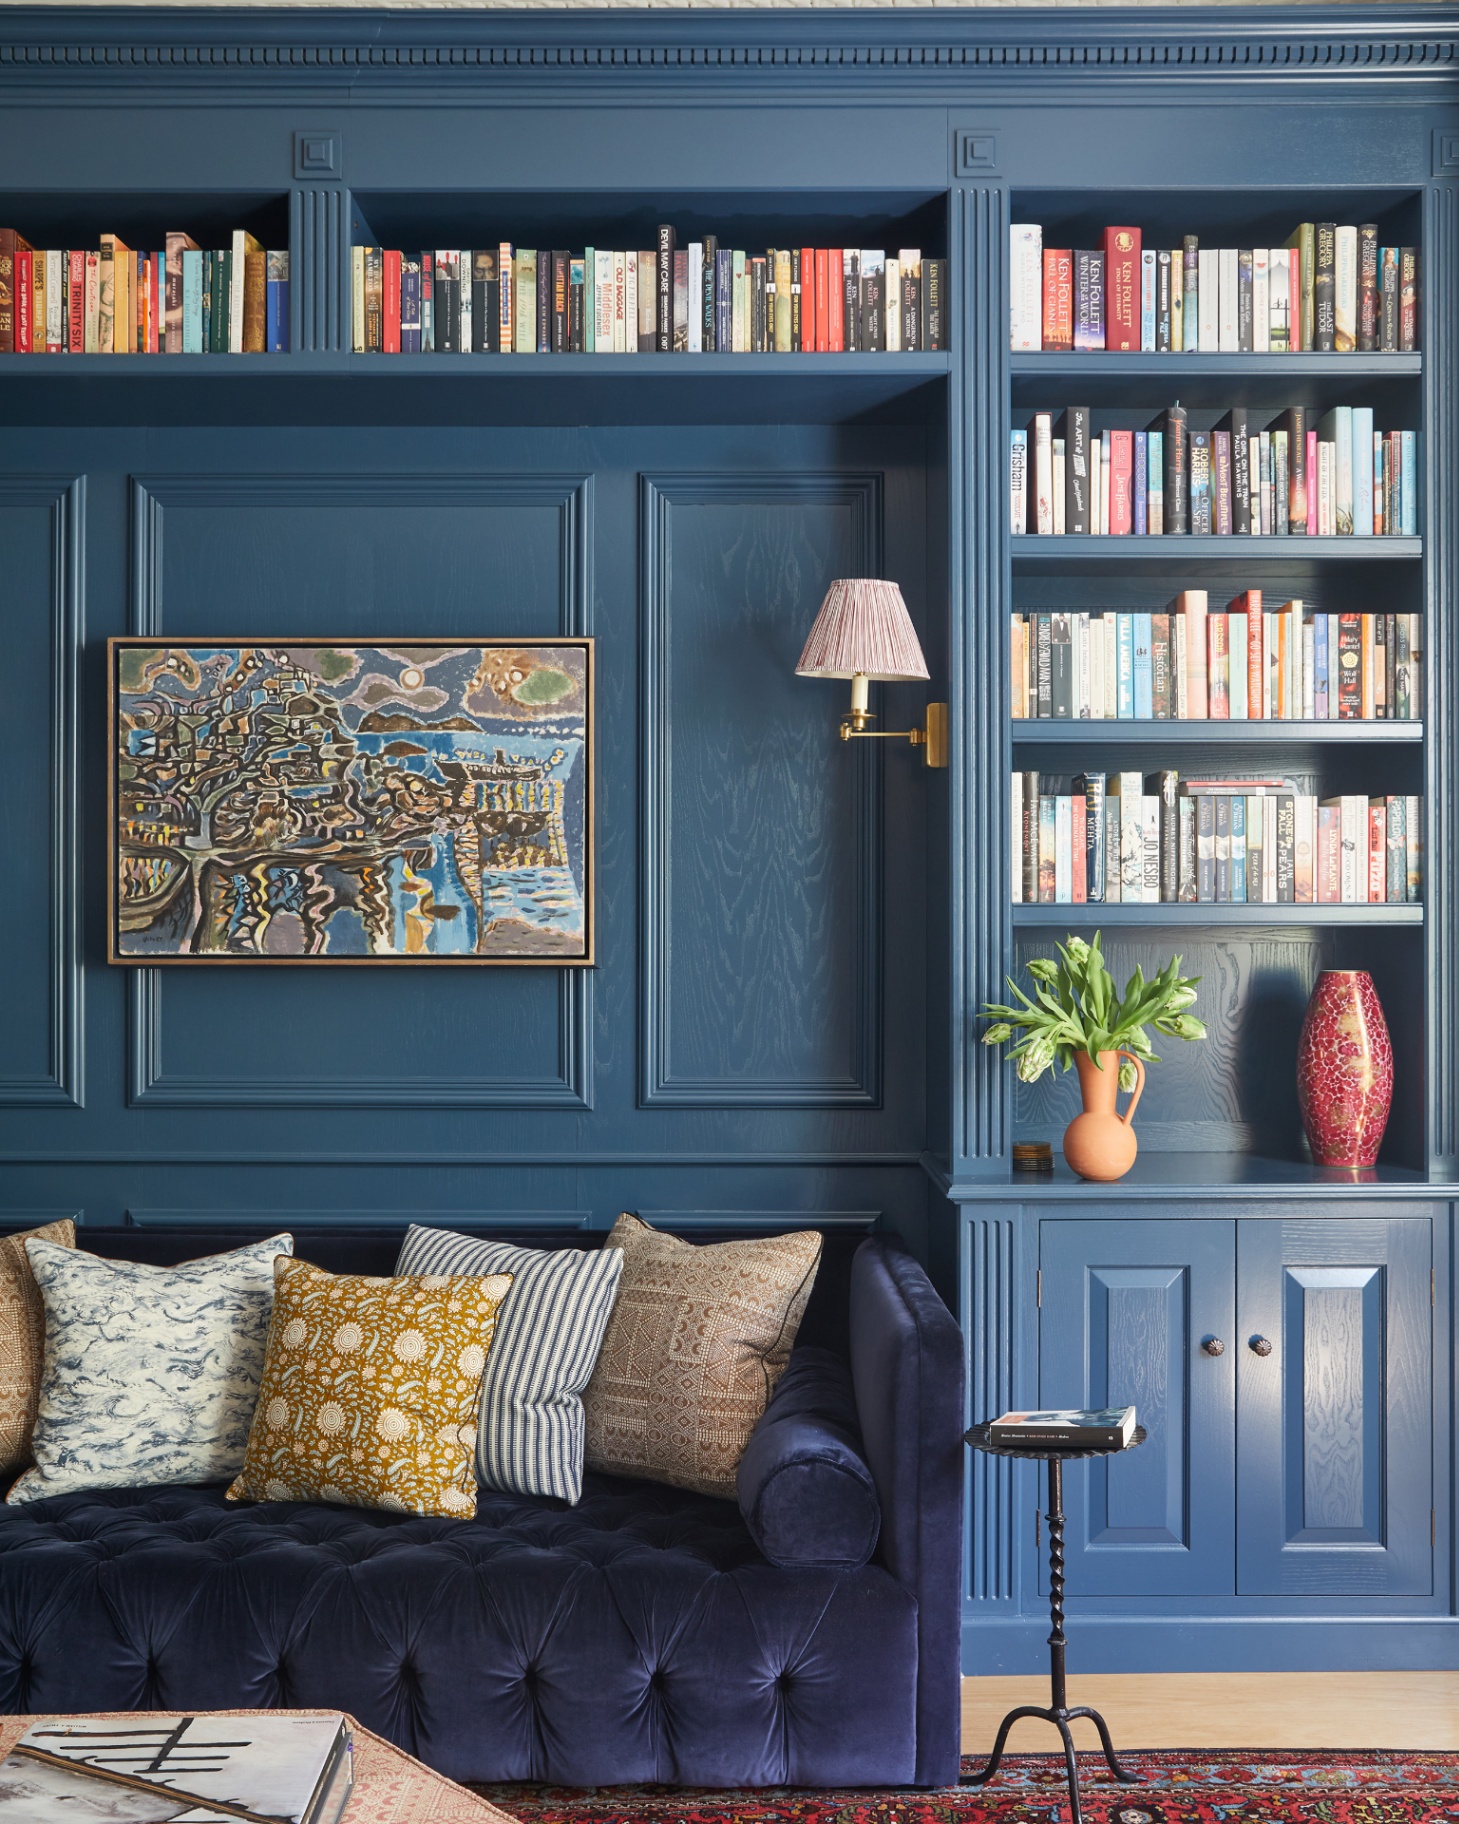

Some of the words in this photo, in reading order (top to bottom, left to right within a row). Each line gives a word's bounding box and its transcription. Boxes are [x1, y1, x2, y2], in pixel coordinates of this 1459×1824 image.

[660, 229, 668, 251] DEVIL
[1318, 229, 1326, 268] GREGORY
[423, 255, 431, 272] HOUSE
[660, 253, 668, 270] MAY
[930, 264, 938, 278] KEN
[1048, 258, 1056, 278] FALL
[1058, 258, 1069, 281] KEN
[1080, 256, 1088, 293] WINTER
[1090, 260, 1101, 282] KEN
[1123, 261, 1132, 282] KEN
[660, 271, 668, 292] CARE
[930, 280, 938, 307] FOLLETT
[1048, 280, 1056, 294] OF
[1116, 284, 1121, 292] OF
[72, 284, 82, 327] TRINITY
[556, 293, 564, 312] BEACH
[602, 283, 612, 336] Middlesex
[1048, 296, 1056, 332] GIANTS
[1058, 284, 1069, 332] FOLLETT
[1090, 285, 1101, 334] FOLLETT
[1123, 285, 1132, 328] FOLLETT
[1080, 302, 1088, 337] WORLD
[72, 329, 82, 347] SIX
[1075, 412, 1083, 426] The
[1173, 418, 1183, 446] Joanne
[1012, 444, 1025, 491] Grisham
[1137, 446, 1145, 498] CHOCOLAT
[1192, 448, 1200, 485] HARRIS
[1200, 448, 1209, 485] ROBERT
[1219, 464, 1228, 487] MOST
[1241, 459, 1247, 470] ON
[1116, 474, 1125, 493] JANE
[1116, 494, 1125, 520] HARRIS
[1193, 510, 1201, 527] SPY
[1201, 497, 1209, 533] OFFICER
[1220, 488, 1228, 527] BEAUTIFUL
[1250, 594, 1260, 620] HARPER
[1120, 616, 1130, 641] VILLA
[1250, 622, 1260, 632] LEE
[1250, 640, 1261, 650] GO
[1250, 652, 1261, 662] SET
[1120, 644, 1130, 681] AMERICA
[1155, 642, 1167, 692] Historian
[1250, 671, 1261, 708] WATCHMAN
[1086, 784, 1102, 812] RAJ
[1392, 800, 1401, 840] PAPILLON
[1144, 837, 1158, 850] JO
[1371, 852, 1384, 891] Puzo
